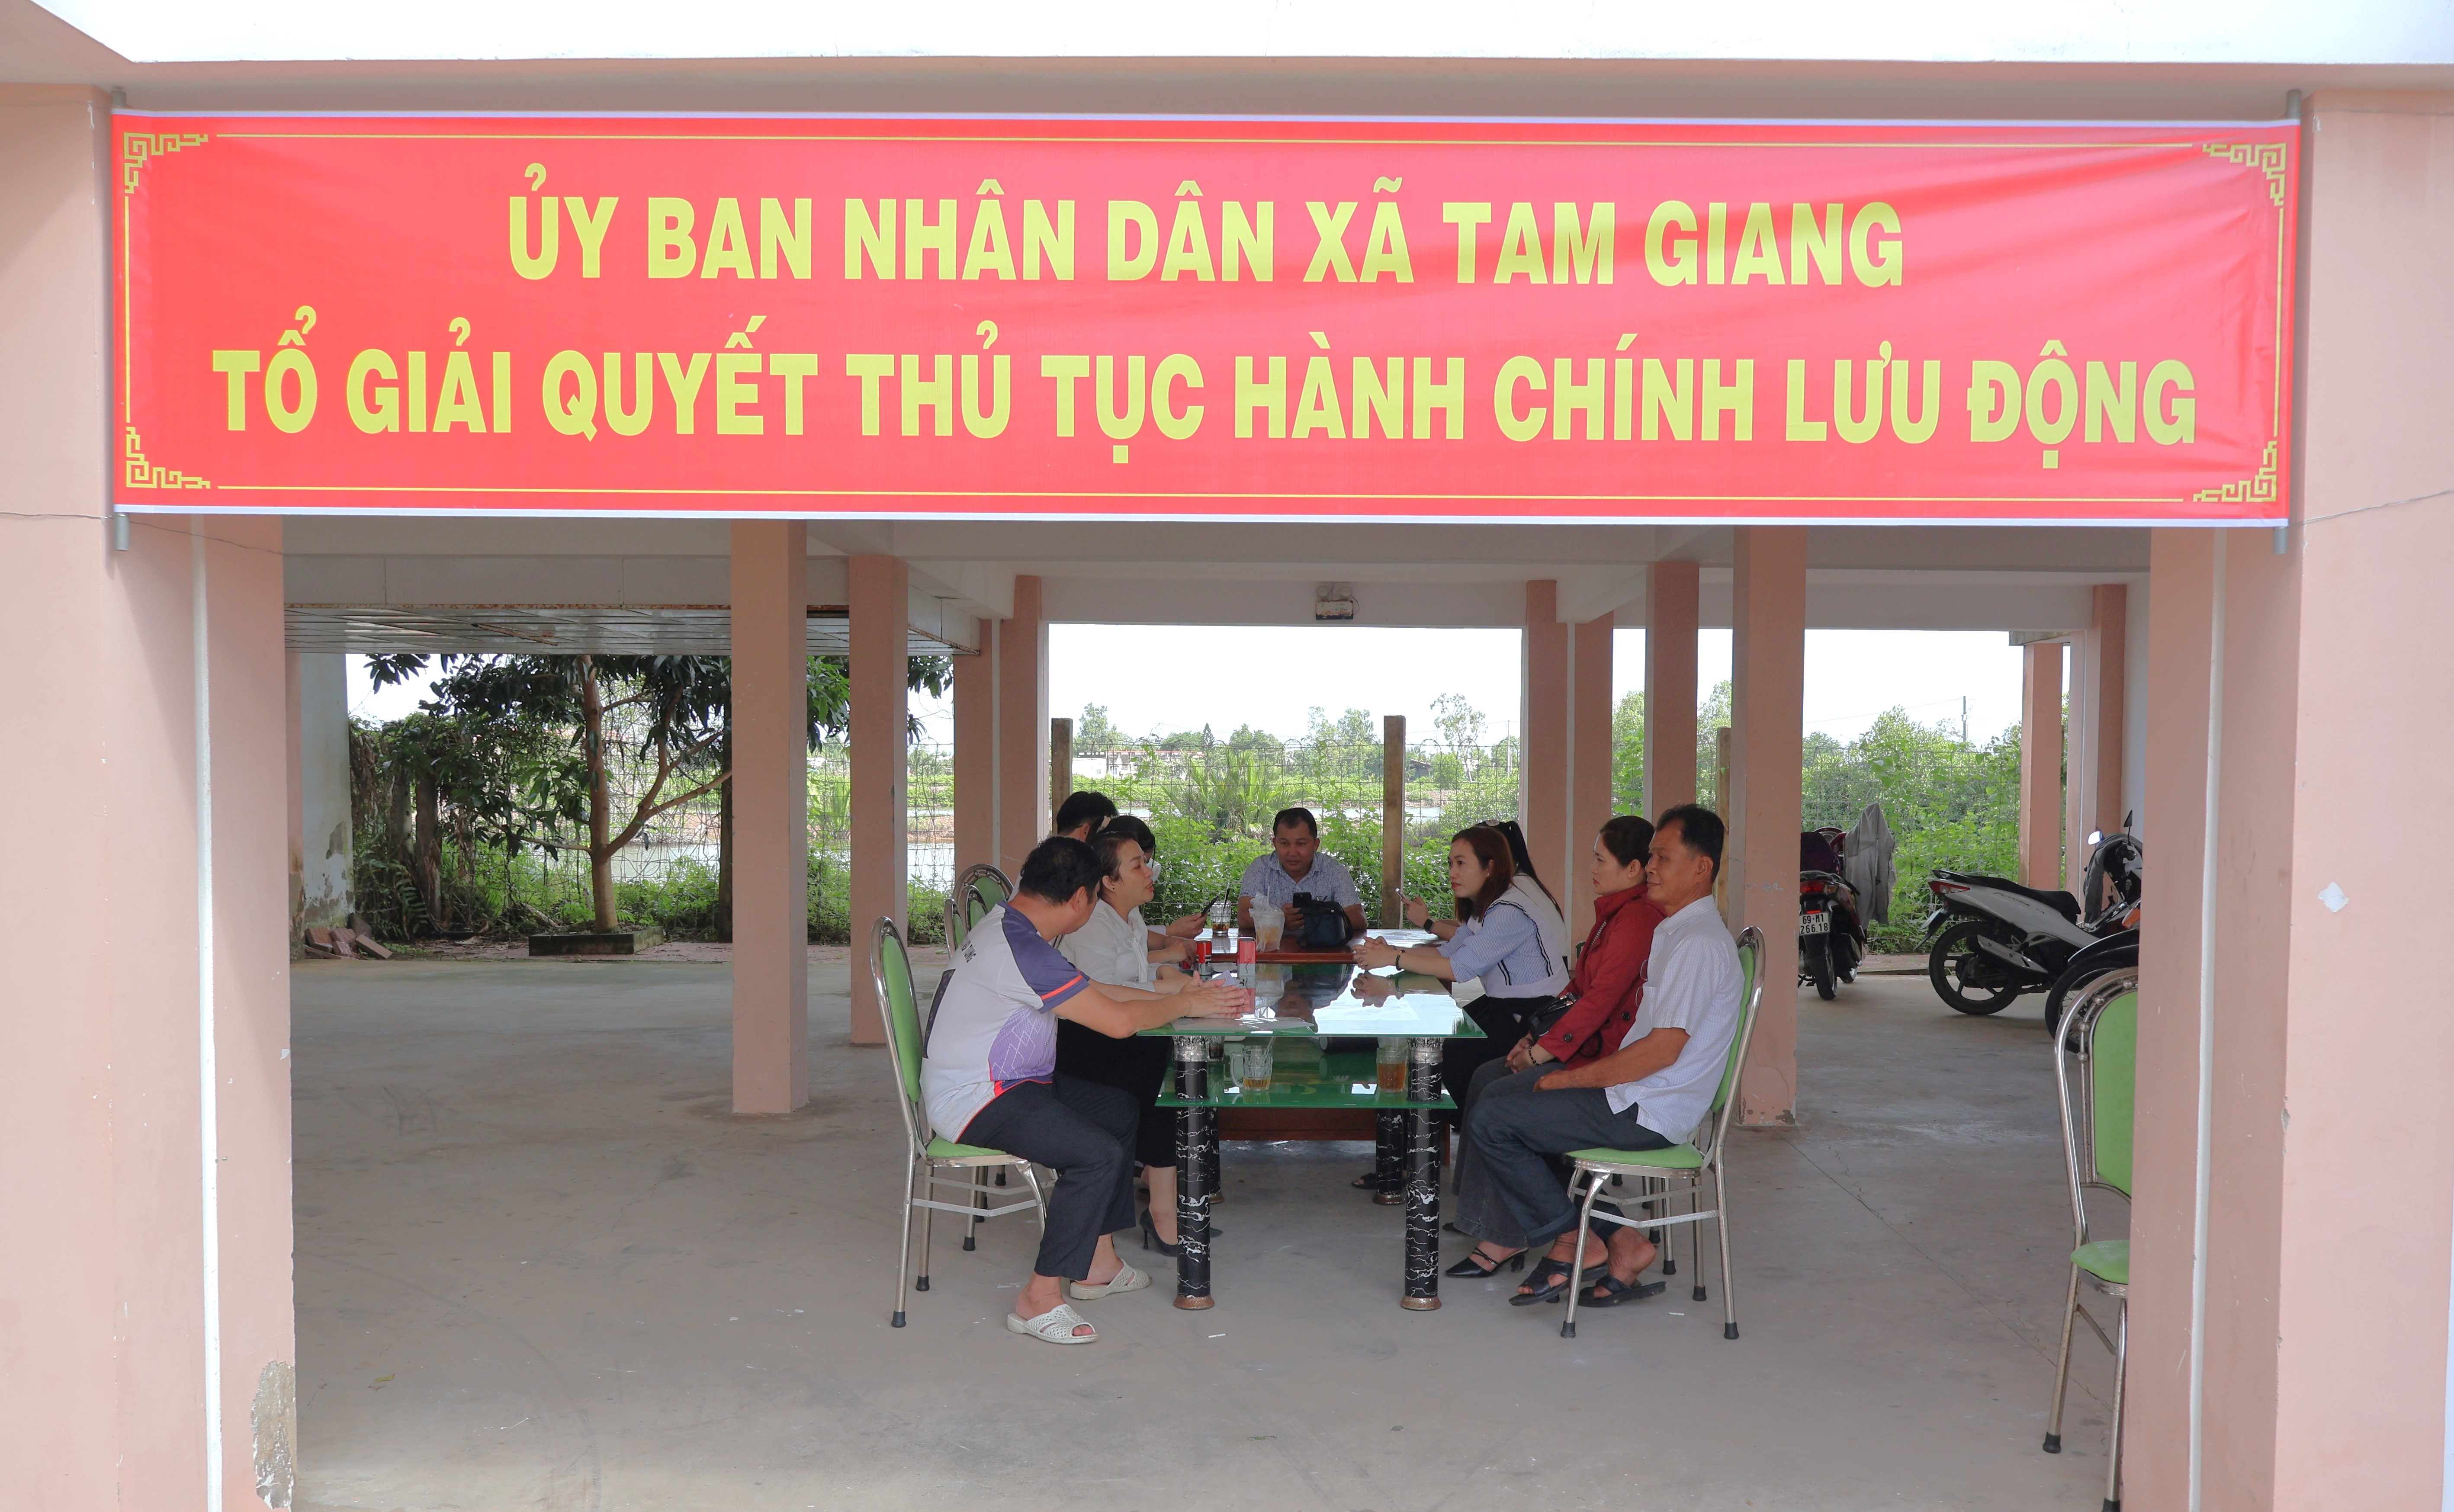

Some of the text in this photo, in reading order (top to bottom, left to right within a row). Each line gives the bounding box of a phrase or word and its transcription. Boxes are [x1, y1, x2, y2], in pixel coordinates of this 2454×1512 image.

[509, 163, 1902, 287] ỦY BAN NHÂN DÂN XÃ TAM GIANG
[212, 305, 2195, 468] TỔ GIẢI QUYẾT THỦ TỤC HÀNH CHÍNH LƯU ĐỘNG
[1800, 923, 1828, 934] 266.18
[1802, 914, 1824, 924] 69-M1
